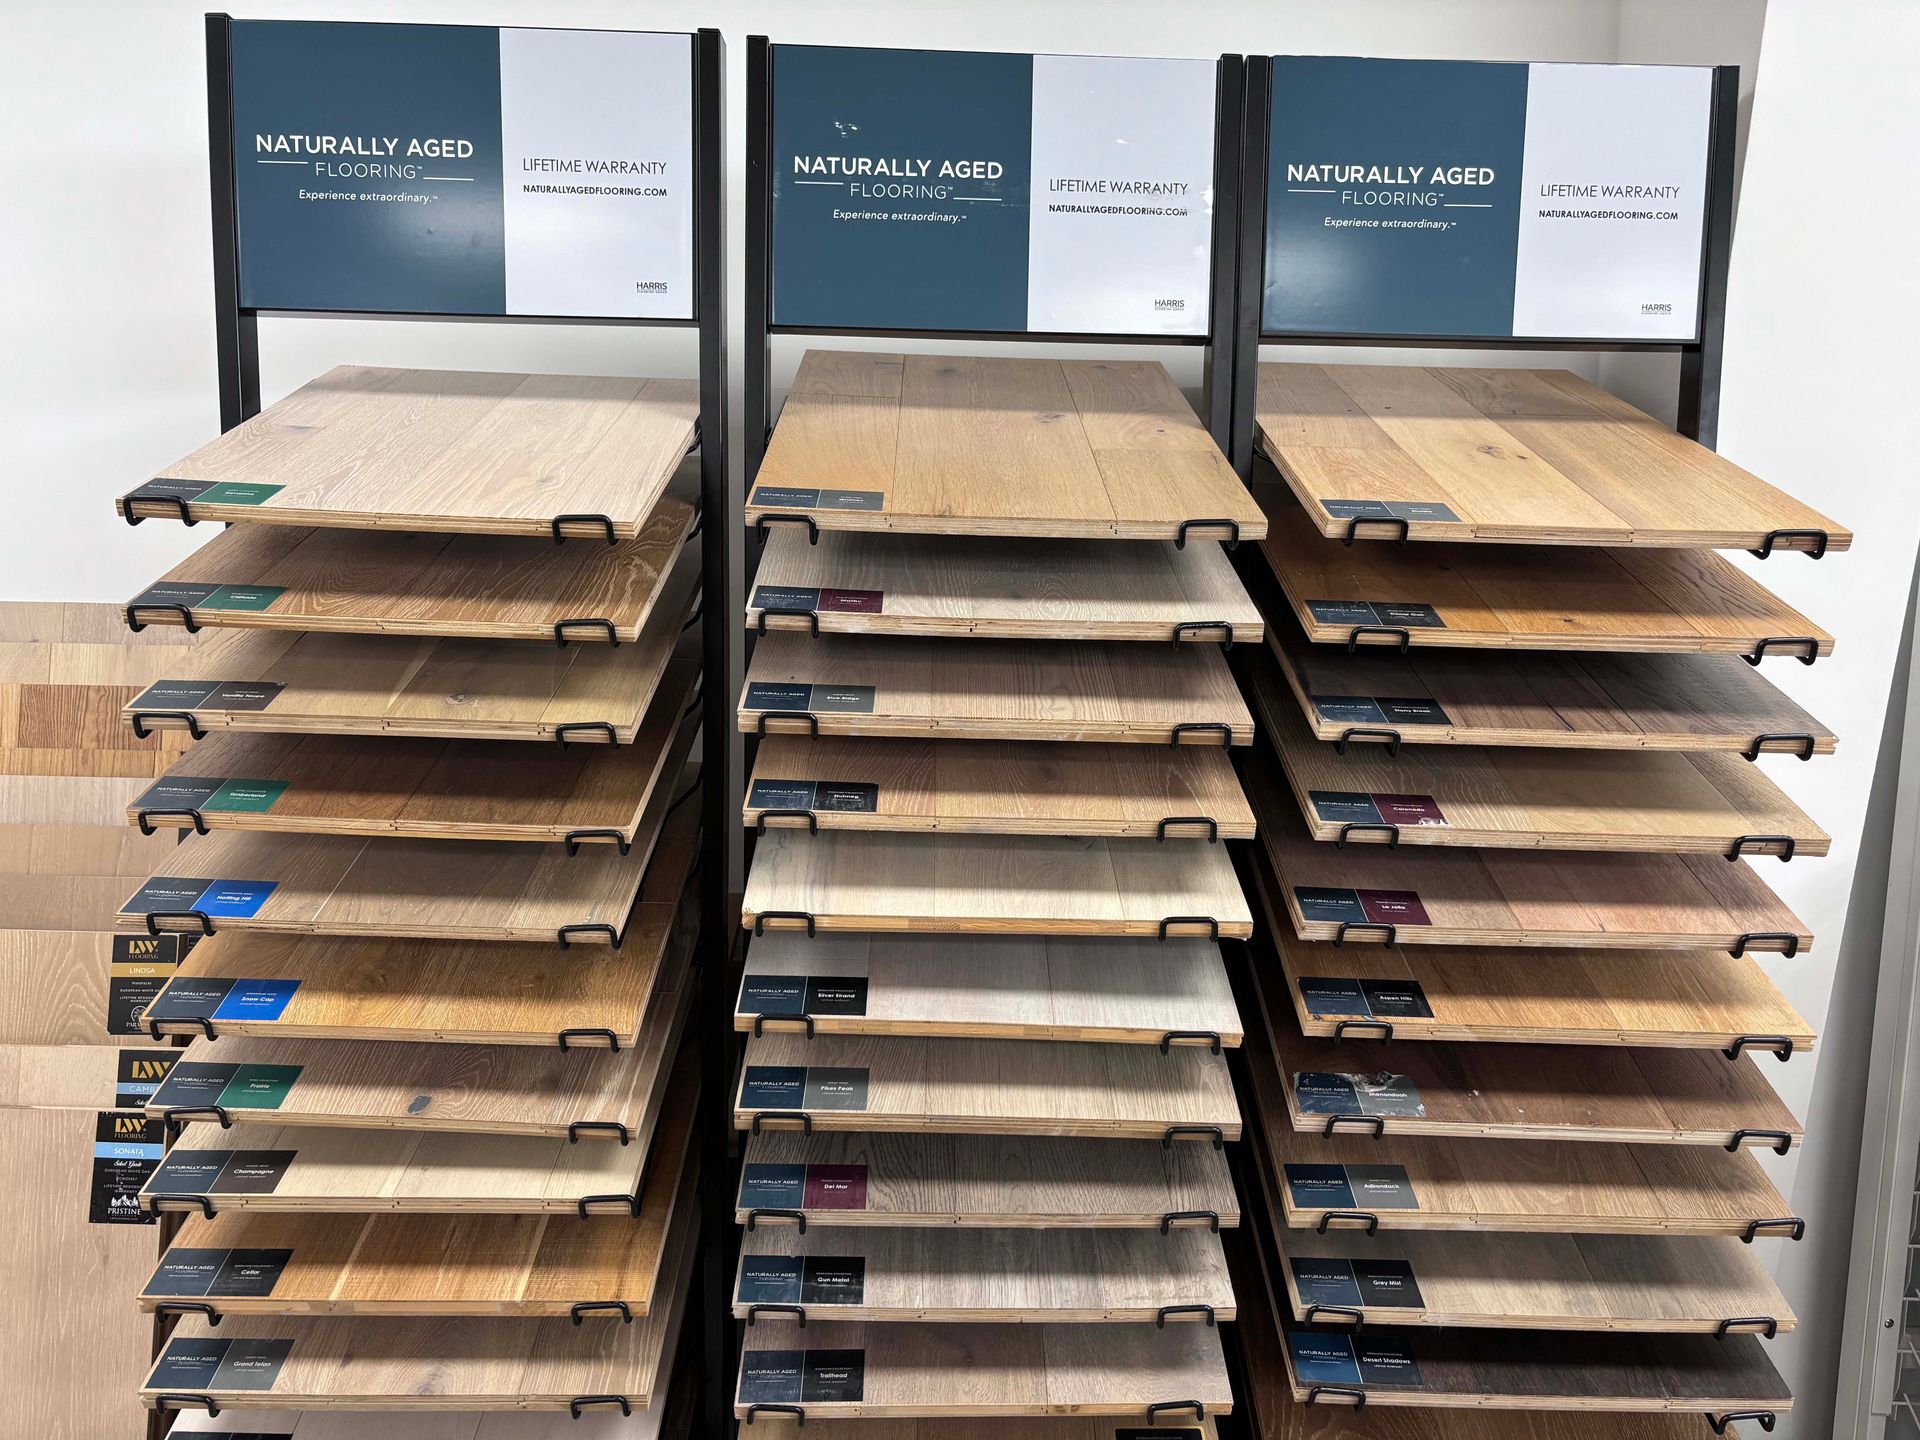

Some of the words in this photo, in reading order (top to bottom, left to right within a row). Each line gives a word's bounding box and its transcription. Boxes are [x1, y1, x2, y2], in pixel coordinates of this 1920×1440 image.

[255, 133, 399, 157] NATURALLY
[405, 137, 474, 159] AGED
[522, 157, 583, 173] LIFETIME
[584, 159, 668, 175] WARRANTY
[794, 155, 932, 178] NATURALLY
[938, 159, 1004, 180] AGED
[1287, 163, 1424, 185] NATURALLY
[1429, 166, 1496, 186] AGED
[522, 184, 668, 197] NATURALLYAGEDFLOORING.COM
[1049, 178, 1107, 193] LIFETIME
[1109, 180, 1189, 196] WARRANTY
[1540, 184, 1598, 198] LIFETIME
[1600, 184, 1680, 199] WARRANTY
[298, 188, 357, 202] Experience
[832, 208, 889, 222] Experience
[1048, 204, 1188, 217] NATURALLYAGEDFLOORING.COM
[1538, 209, 1679, 221] NATURALLYAGEDFLOORING.COM
[1324, 216, 1379, 229] Experience
[636, 281, 669, 291] HARRIS
[1154, 299, 1185, 308] HARRIS
[1641, 303, 1672, 312] HARRIS
[229, 791, 267, 799] Timberland
[144, 888, 181, 896] NATURALLY
[129, 967, 156, 975] LINOSA
[249, 1082, 270, 1090] Prairie
[113, 1147, 145, 1155] SONATA
[233, 1168, 275, 1176] Champagne
[107, 1207, 142, 1215] PRISTINE
[1372, 1279, 1389, 1287] Grey
[1382, 1357, 1412, 1365] Shadows
